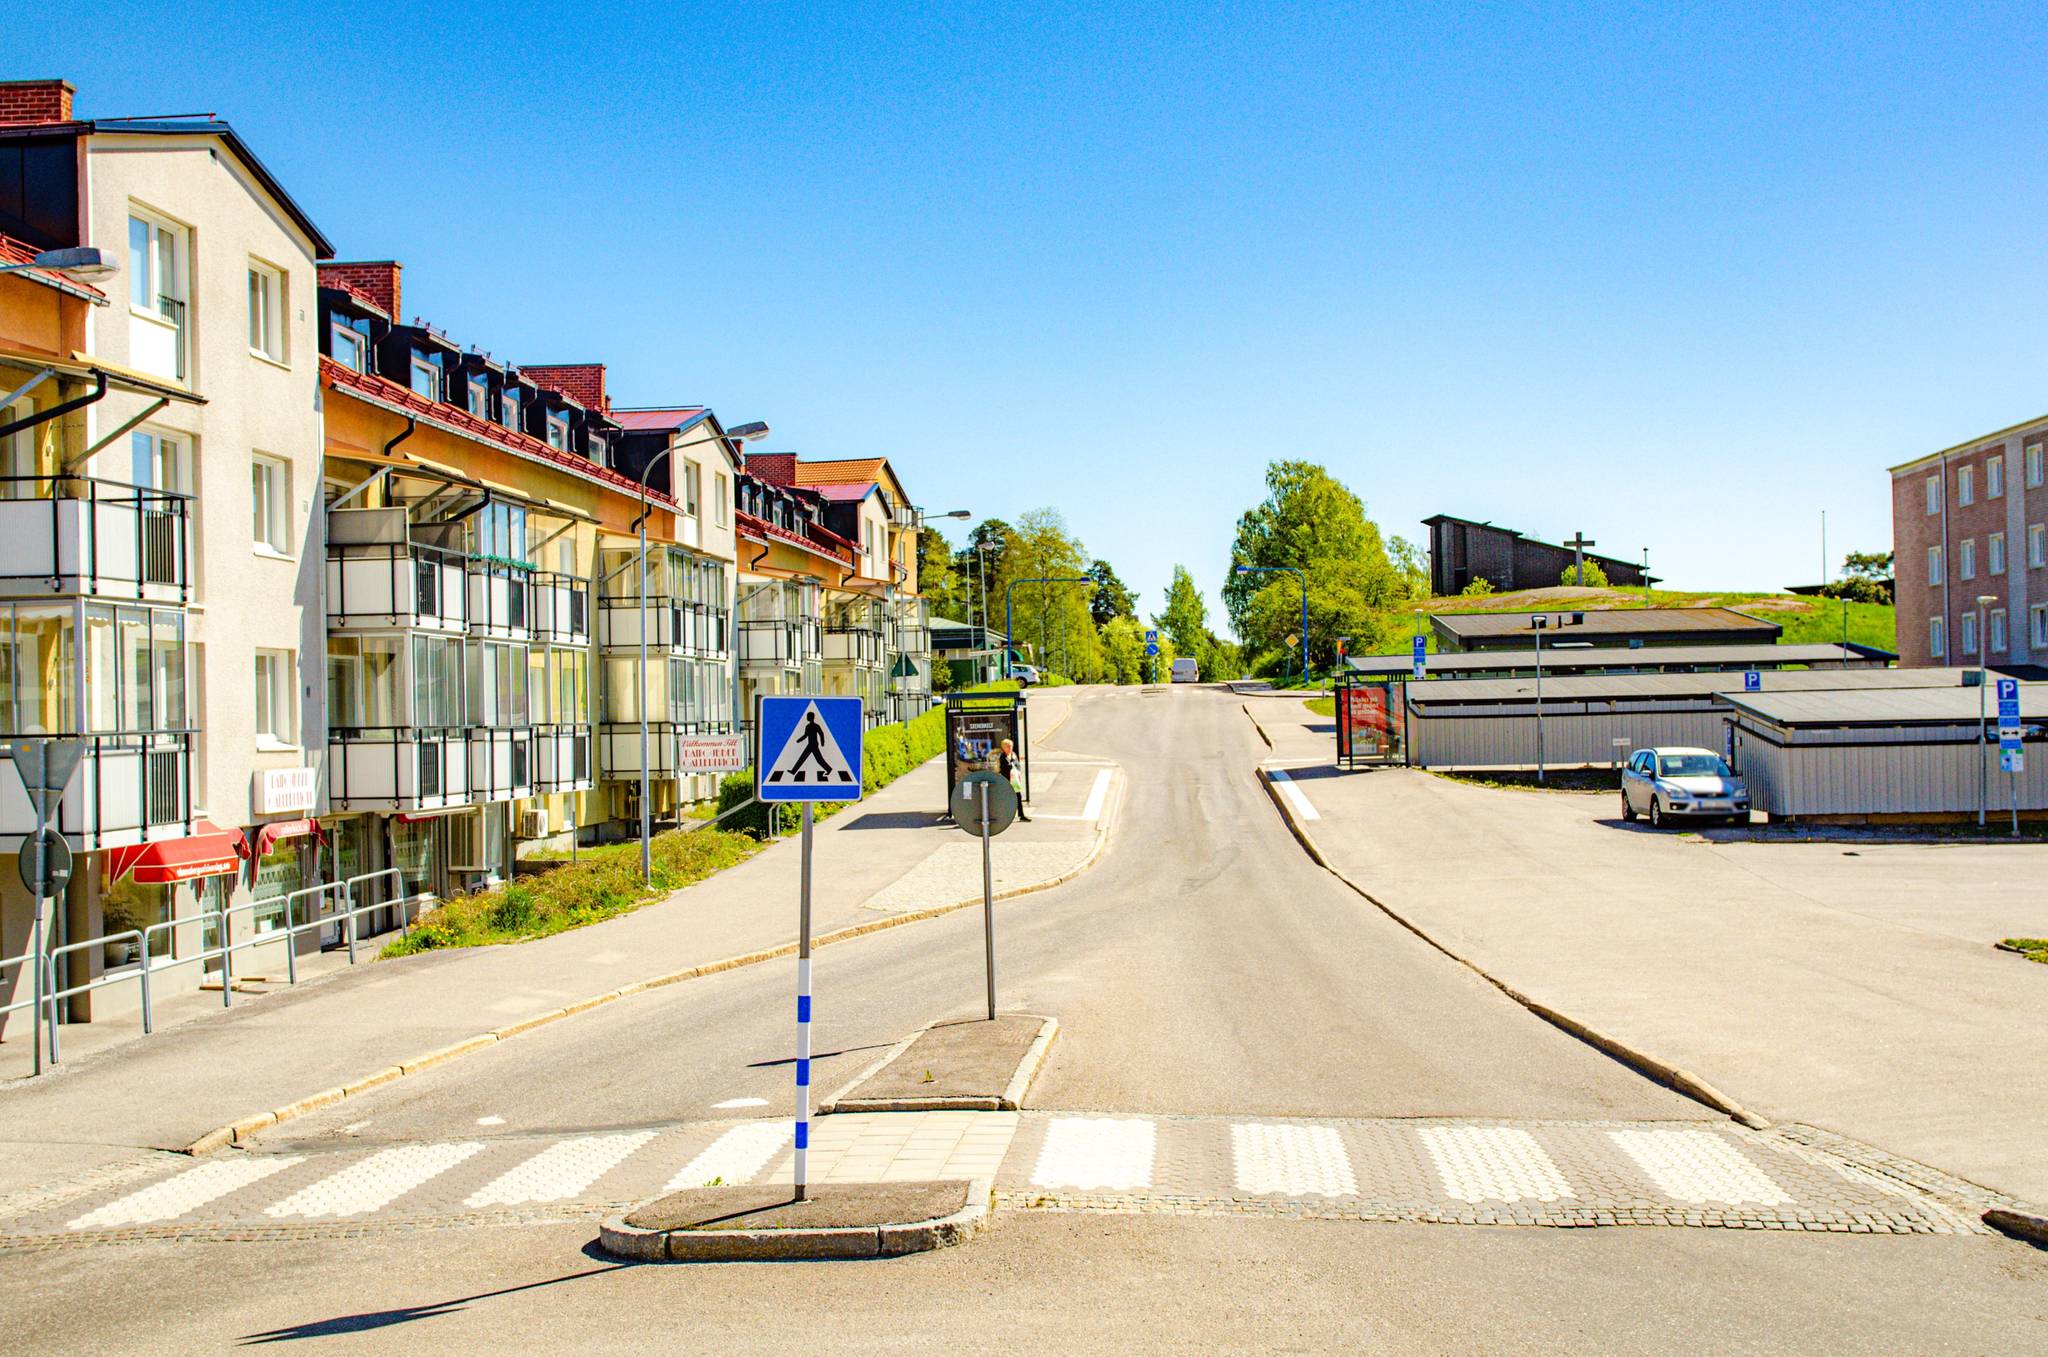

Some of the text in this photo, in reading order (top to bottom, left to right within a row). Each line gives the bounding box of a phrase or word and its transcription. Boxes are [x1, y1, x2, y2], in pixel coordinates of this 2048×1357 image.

[1416, 637, 1423, 647] P
[1749, 673, 1757, 686] P
[2002, 681, 2014, 699] P
